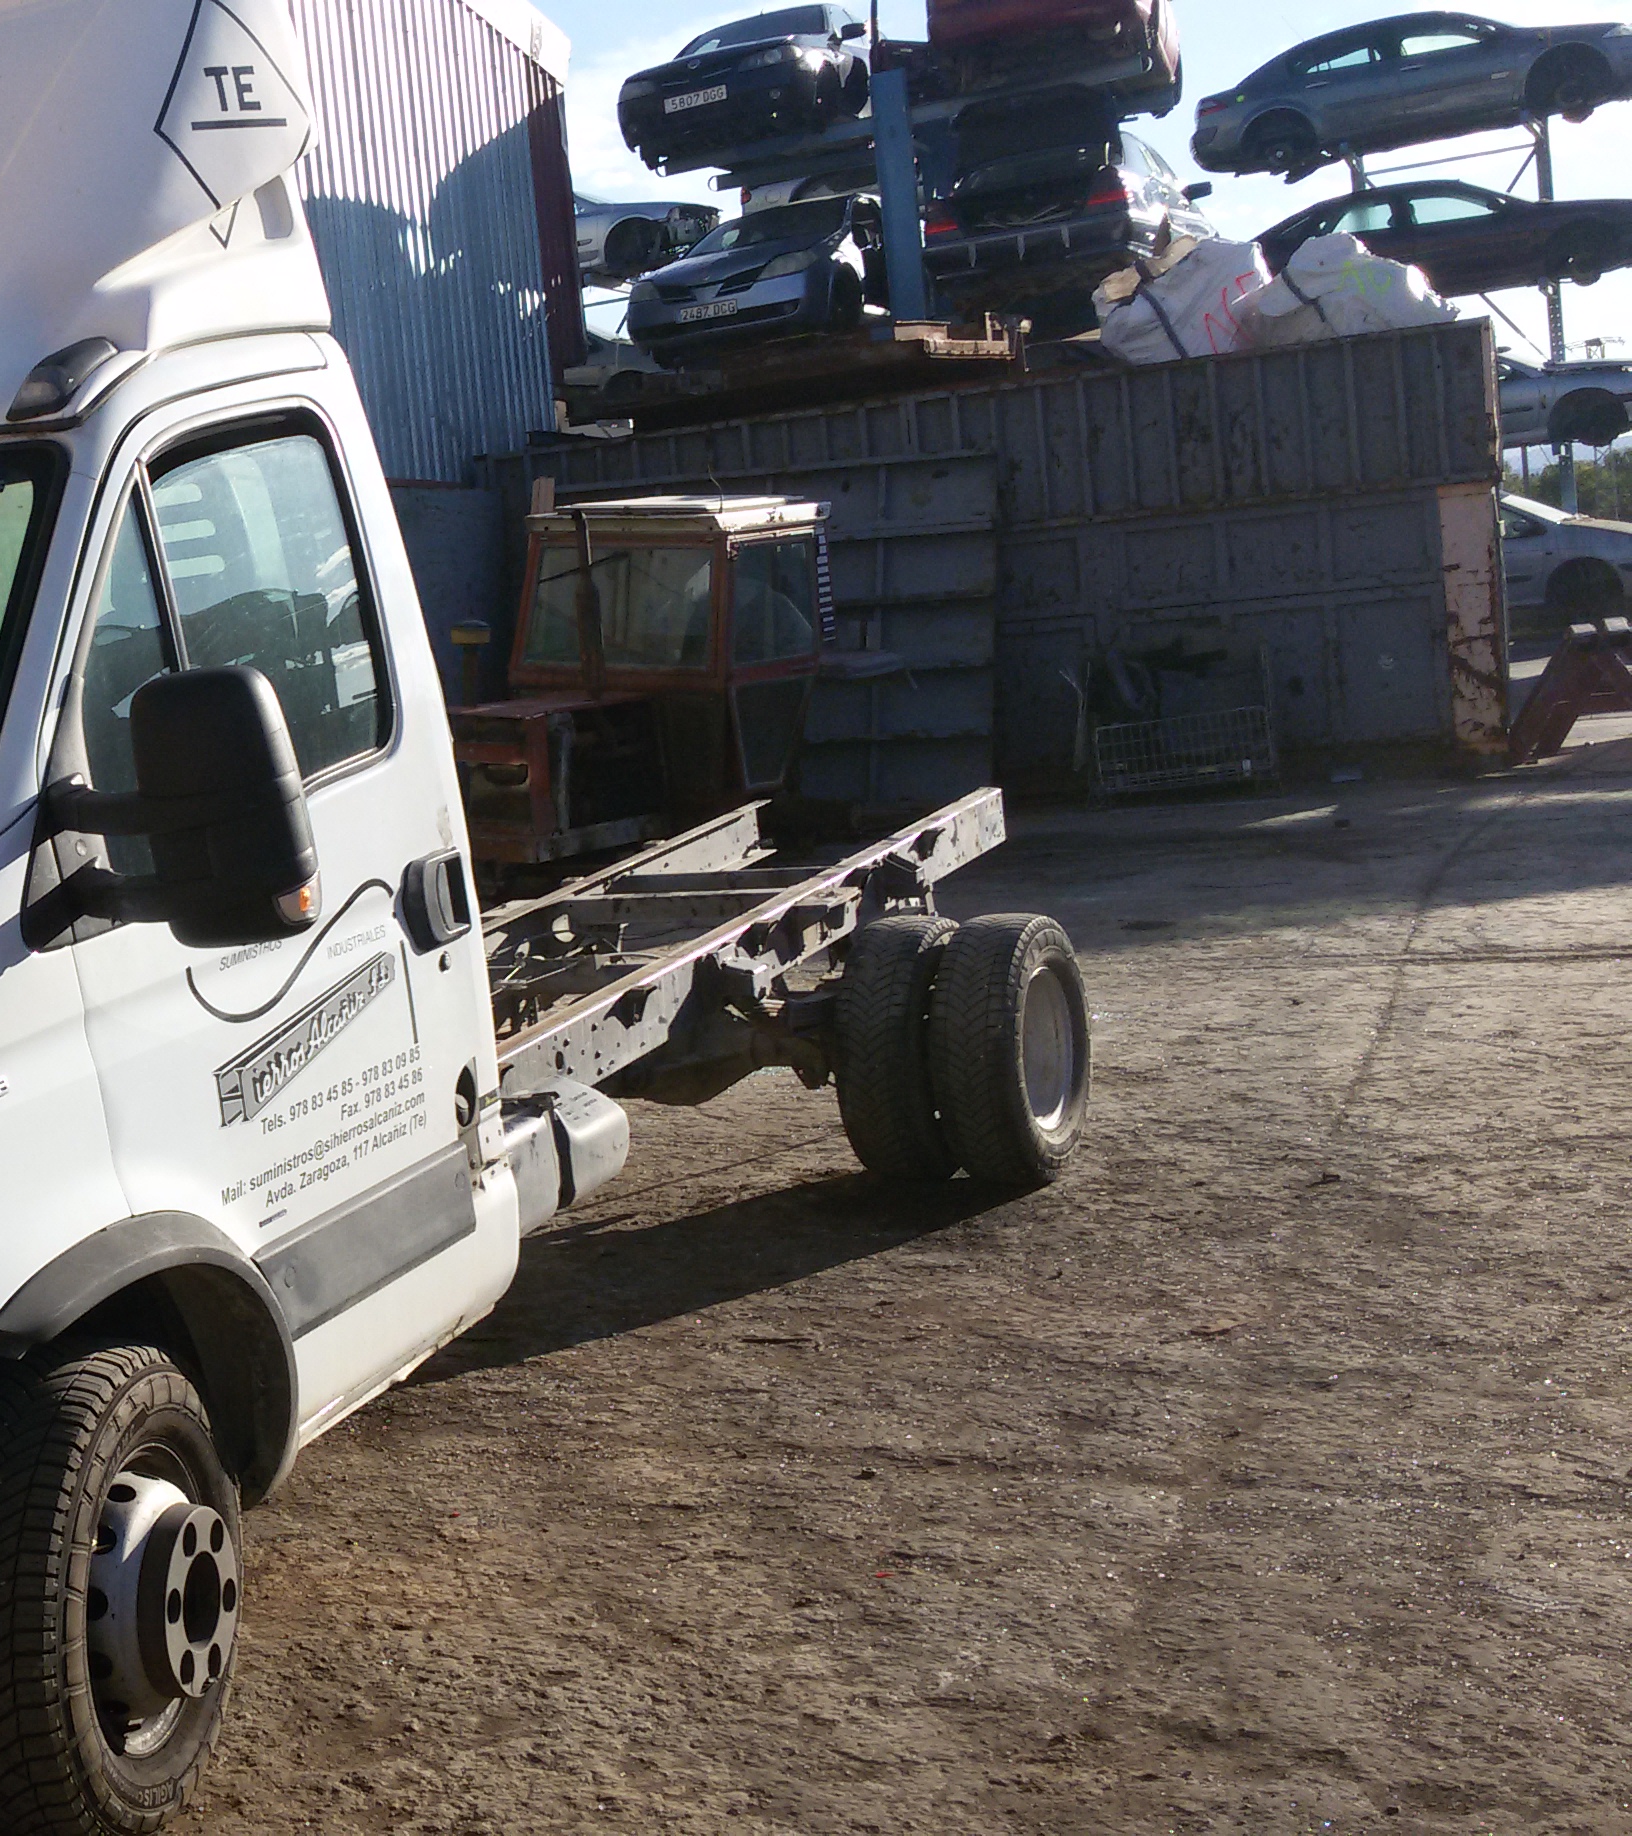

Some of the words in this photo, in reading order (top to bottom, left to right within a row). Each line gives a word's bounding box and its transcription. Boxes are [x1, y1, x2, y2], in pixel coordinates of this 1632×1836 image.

[203, 65, 261, 112] TE
[671, 93, 700, 110] 5807
[702, 87, 724, 102] DGG
[327, 925, 386, 960] INDUSTRIALES
[261, 1114, 287, 1135] Tels.
[289, 1099, 309, 1121] 978
[311, 1091, 324, 1111] 83
[326, 1084, 339, 1103] 45
[341, 1078, 354, 1097] 85
[361, 1065, 379, 1087] 978
[381, 1058, 393, 1077] 83
[395, 1052, 407, 1071] 09
[409, 1045, 421, 1064] 85
[340, 1101, 362, 1121] Fax.
[364, 1087, 382, 1109] 978
[384, 1080, 396, 1099] 83
[398, 1073, 410, 1091] 45
[411, 1067, 423, 1085] 86
[221, 1179, 247, 1206] Mail:
[249, 1092, 425, 1191] suministros@sihierrosalcaniz.com
[266, 1181, 297, 1208] Avda.
[299, 1154, 350, 1190] Zaragoza,
[353, 1139, 369, 1161] 117
[371, 1122, 407, 1152] Alcañiz
[409, 1110, 427, 1136] (Te)
